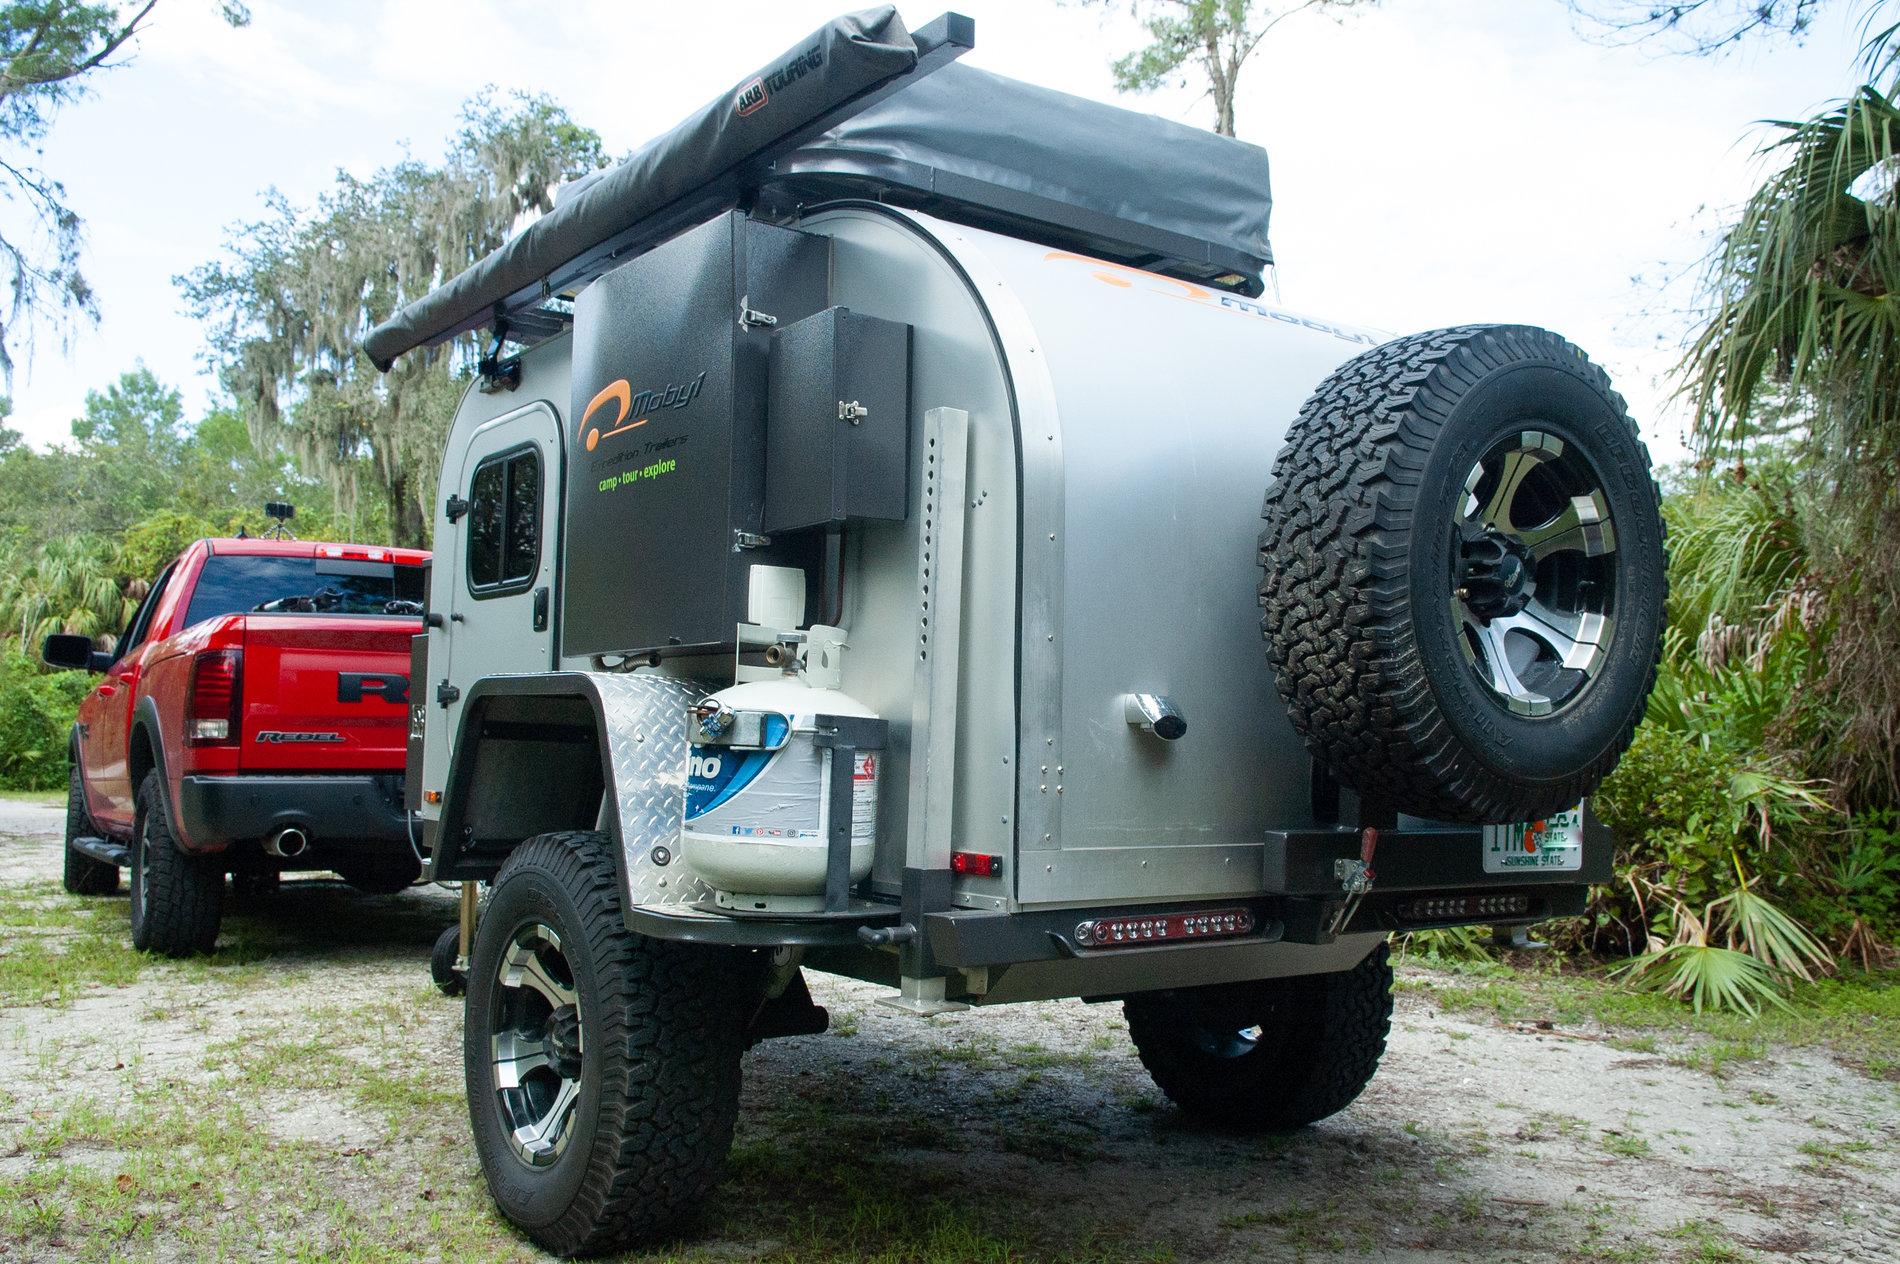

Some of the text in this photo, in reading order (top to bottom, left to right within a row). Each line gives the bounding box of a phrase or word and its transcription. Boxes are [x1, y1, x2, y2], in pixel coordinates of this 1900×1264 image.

[738, 83, 765, 112] ARB
[599, 458, 676, 492] camp tour explore
[337, 671, 410, 703] R
[255, 730, 347, 744] REBEL
[1541, 855, 1564, 867] STATE
